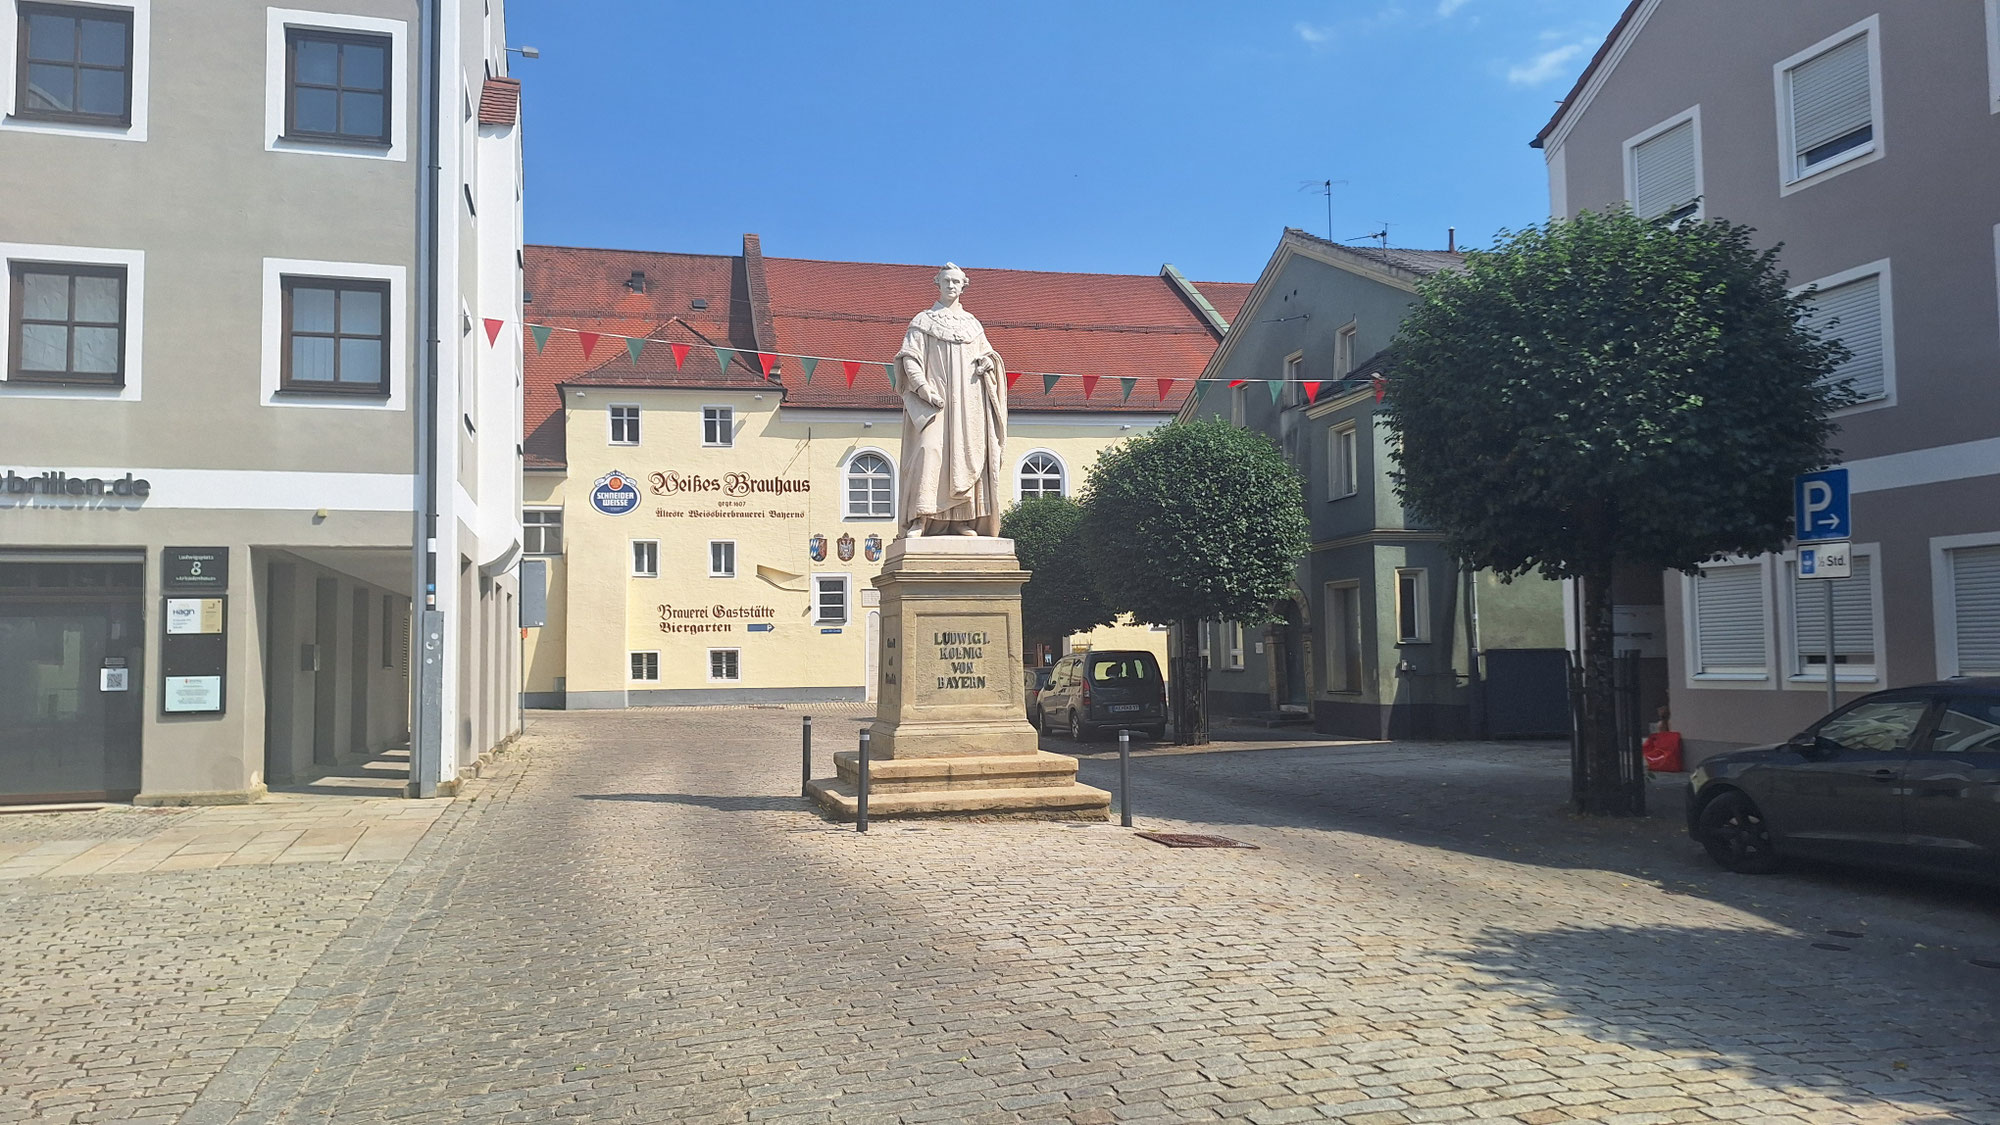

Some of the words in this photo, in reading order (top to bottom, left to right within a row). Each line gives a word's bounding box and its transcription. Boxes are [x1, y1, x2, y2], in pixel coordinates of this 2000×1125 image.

[7, 469, 151, 497] brillen.de
[647, 470, 721, 496] Weißes
[723, 471, 811, 497] Brauhaus
[596, 492, 634, 500] SCHNEIDER
[602, 499, 629, 507] WEISSE
[1803, 480, 1832, 532] P
[768, 510, 805, 519] Bayerns
[1826, 555, 1847, 567] Std.
[190, 561, 202, 576] 8
[657, 604, 709, 620] Brauerei
[712, 604, 776, 618] Gaststätte
[659, 622, 732, 635] Biergarten
[934, 631, 981, 645] LUDWIG
[939, 647, 983, 660] KOENIG
[950, 662, 974, 674] VON
[937, 676, 986, 689] BAYERN
